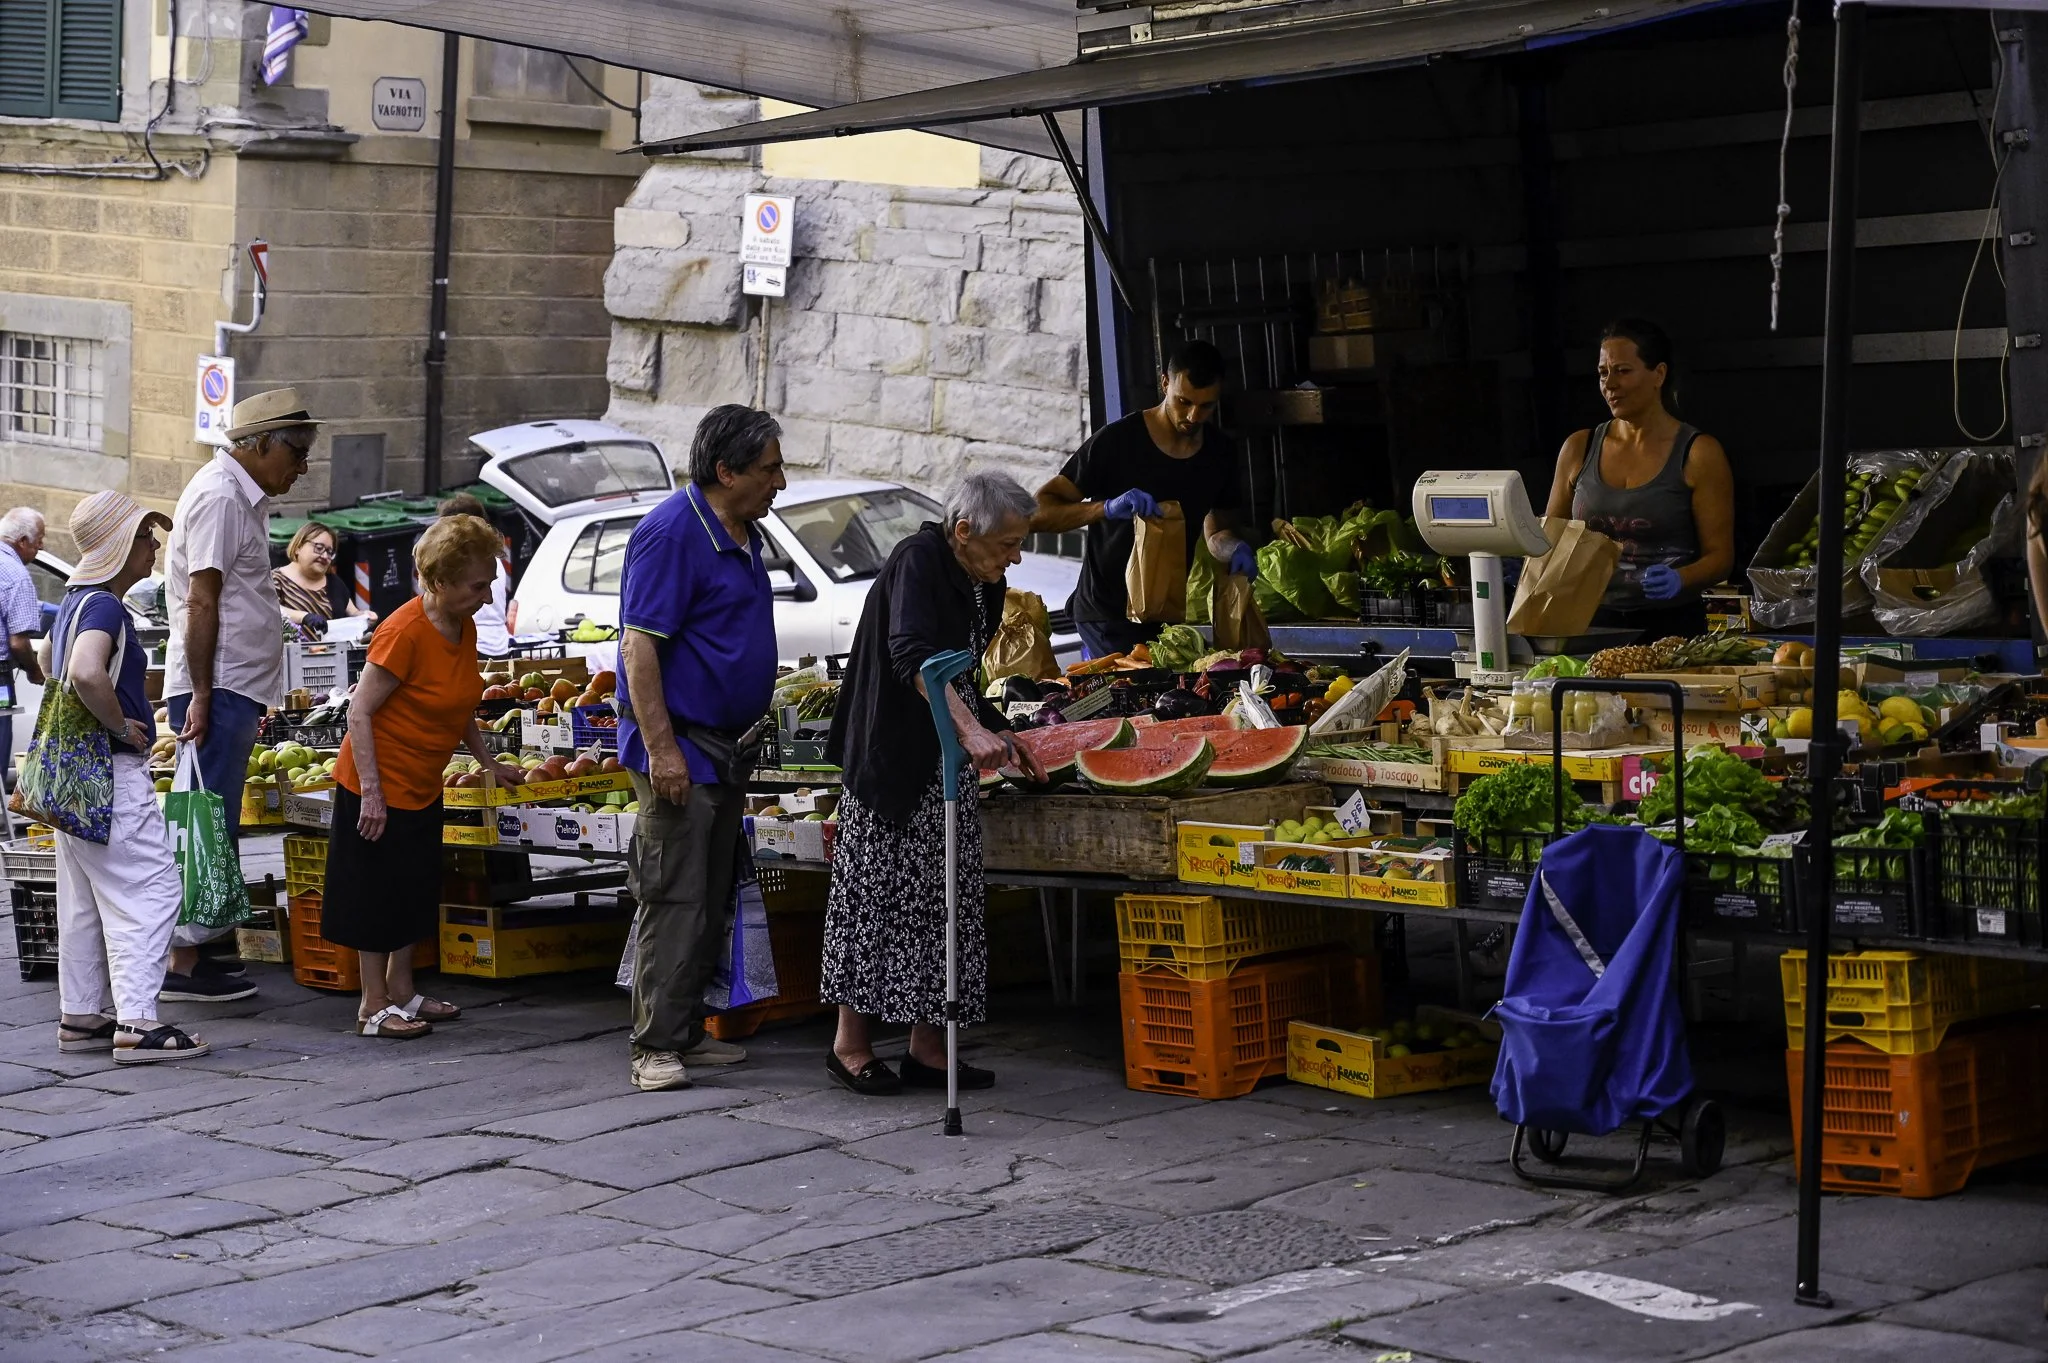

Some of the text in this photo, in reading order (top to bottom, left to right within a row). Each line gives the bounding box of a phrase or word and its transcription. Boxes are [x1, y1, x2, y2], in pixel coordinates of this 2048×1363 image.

[390, 88, 411, 99] VIA
[378, 104, 421, 118] VAGNOTTI
[1661, 722, 1704, 736] Toscno
[1479, 760, 1511, 769] RANCO
[1321, 763, 1419, 783] Prodotto Toscano
[578, 778, 614, 792] FRANCO
[499, 820, 520, 832] Melinda
[556, 822, 579, 835] Melinda
[1230, 860, 1255, 876] FRAN
[1296, 876, 1321, 888] FRANCO
[1391, 886, 1418, 898] FRANCO
[1337, 1064, 1370, 1082] FRANCO
